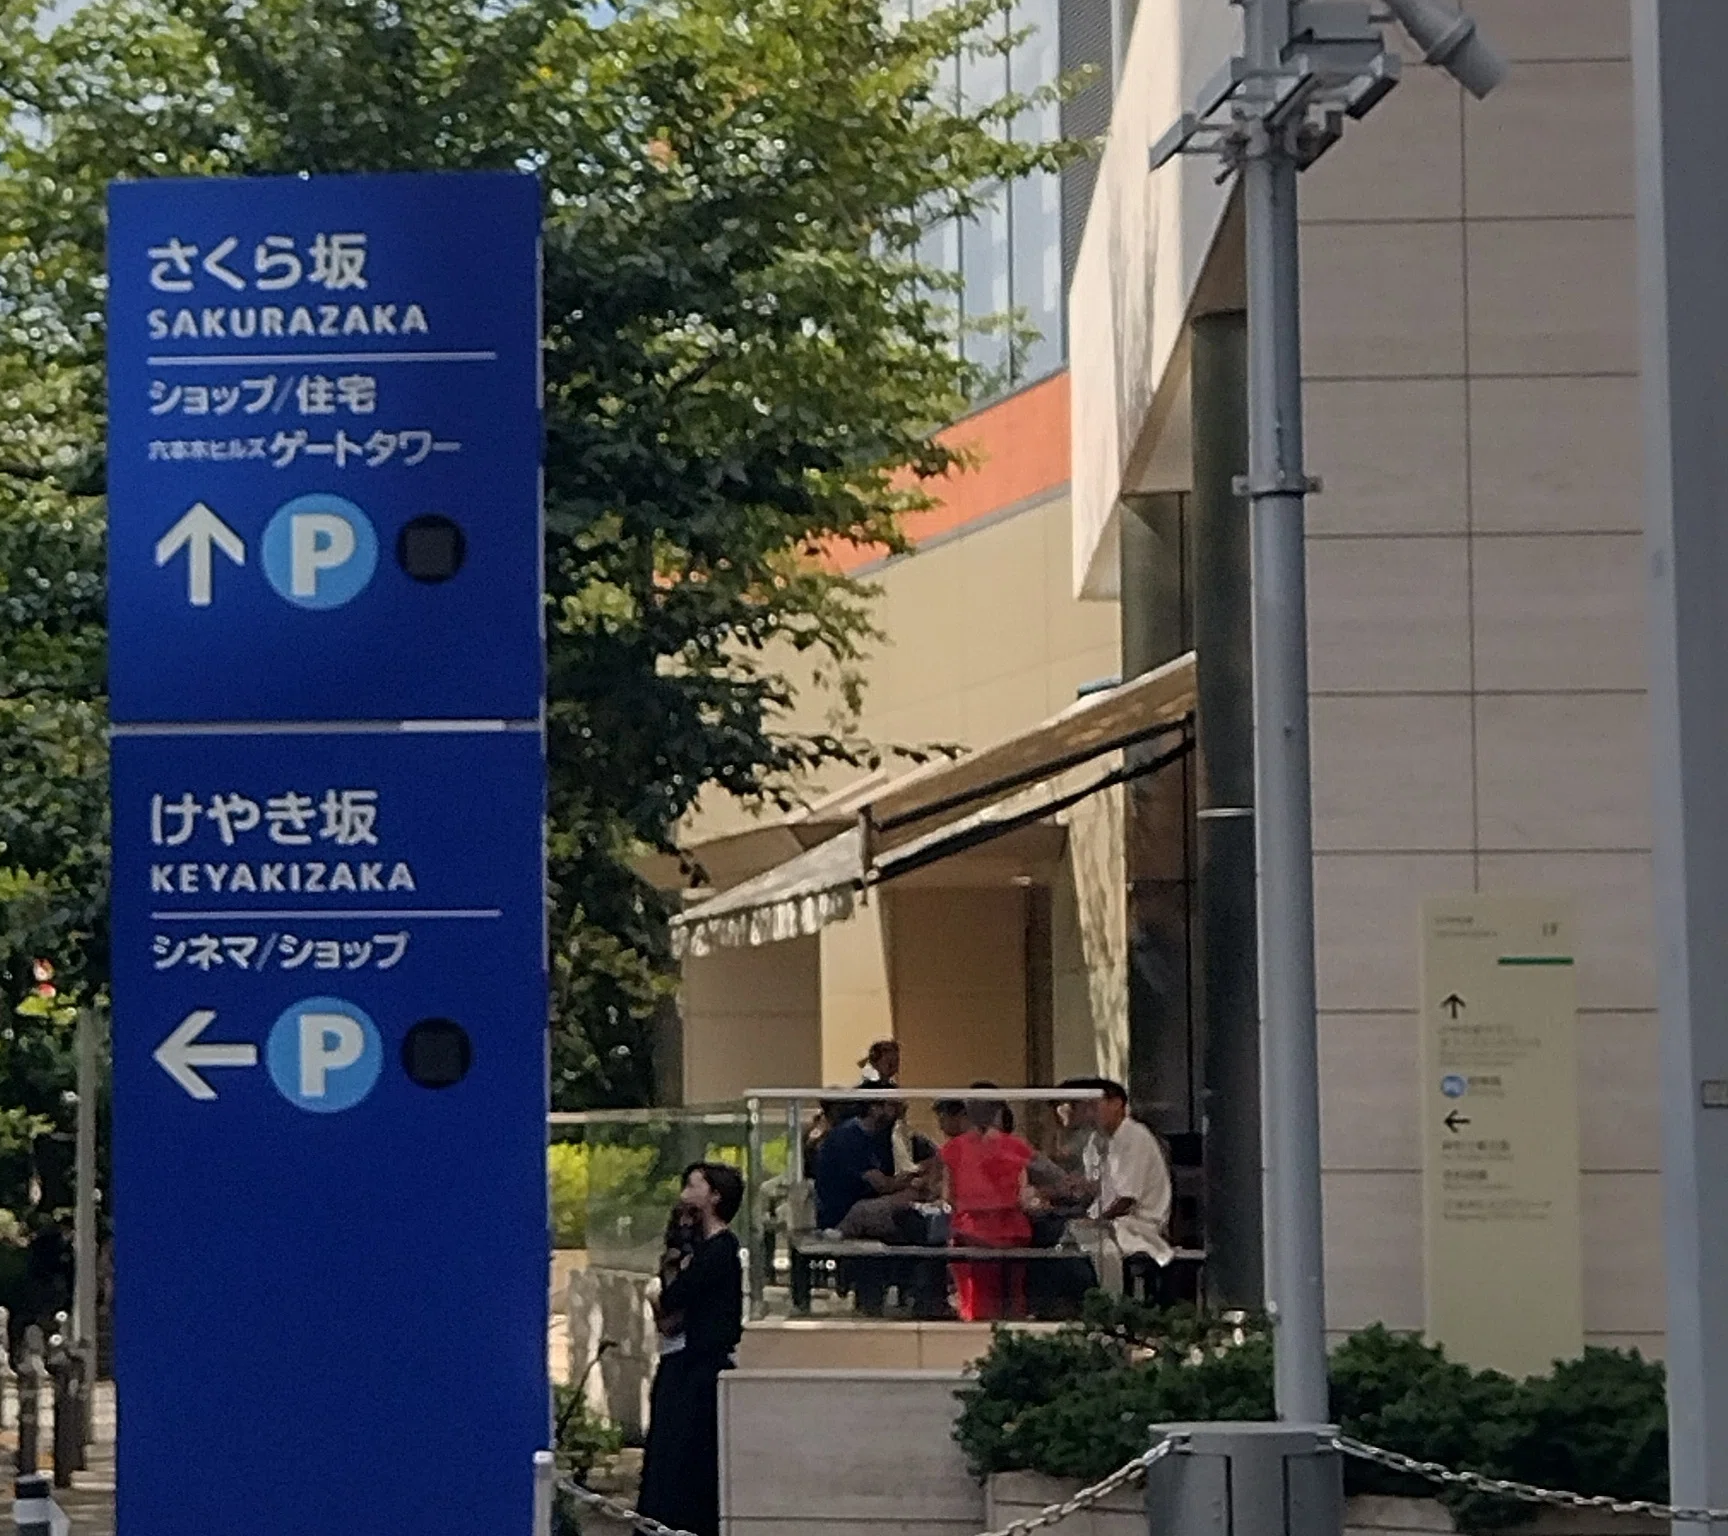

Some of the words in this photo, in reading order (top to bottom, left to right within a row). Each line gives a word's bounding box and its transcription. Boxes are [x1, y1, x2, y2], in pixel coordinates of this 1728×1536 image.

[147, 232, 368, 292] さくら坂
[146, 304, 429, 340] SAKURAZAKA
[148, 374, 377, 416] ショップ/住宅
[290, 513, 357, 598] P
[150, 789, 379, 846] けやき坂
[150, 862, 417, 894] KEYAKIZAKA
[151, 930, 411, 971] シネマ/ショップ
[298, 1013, 366, 1098] P
